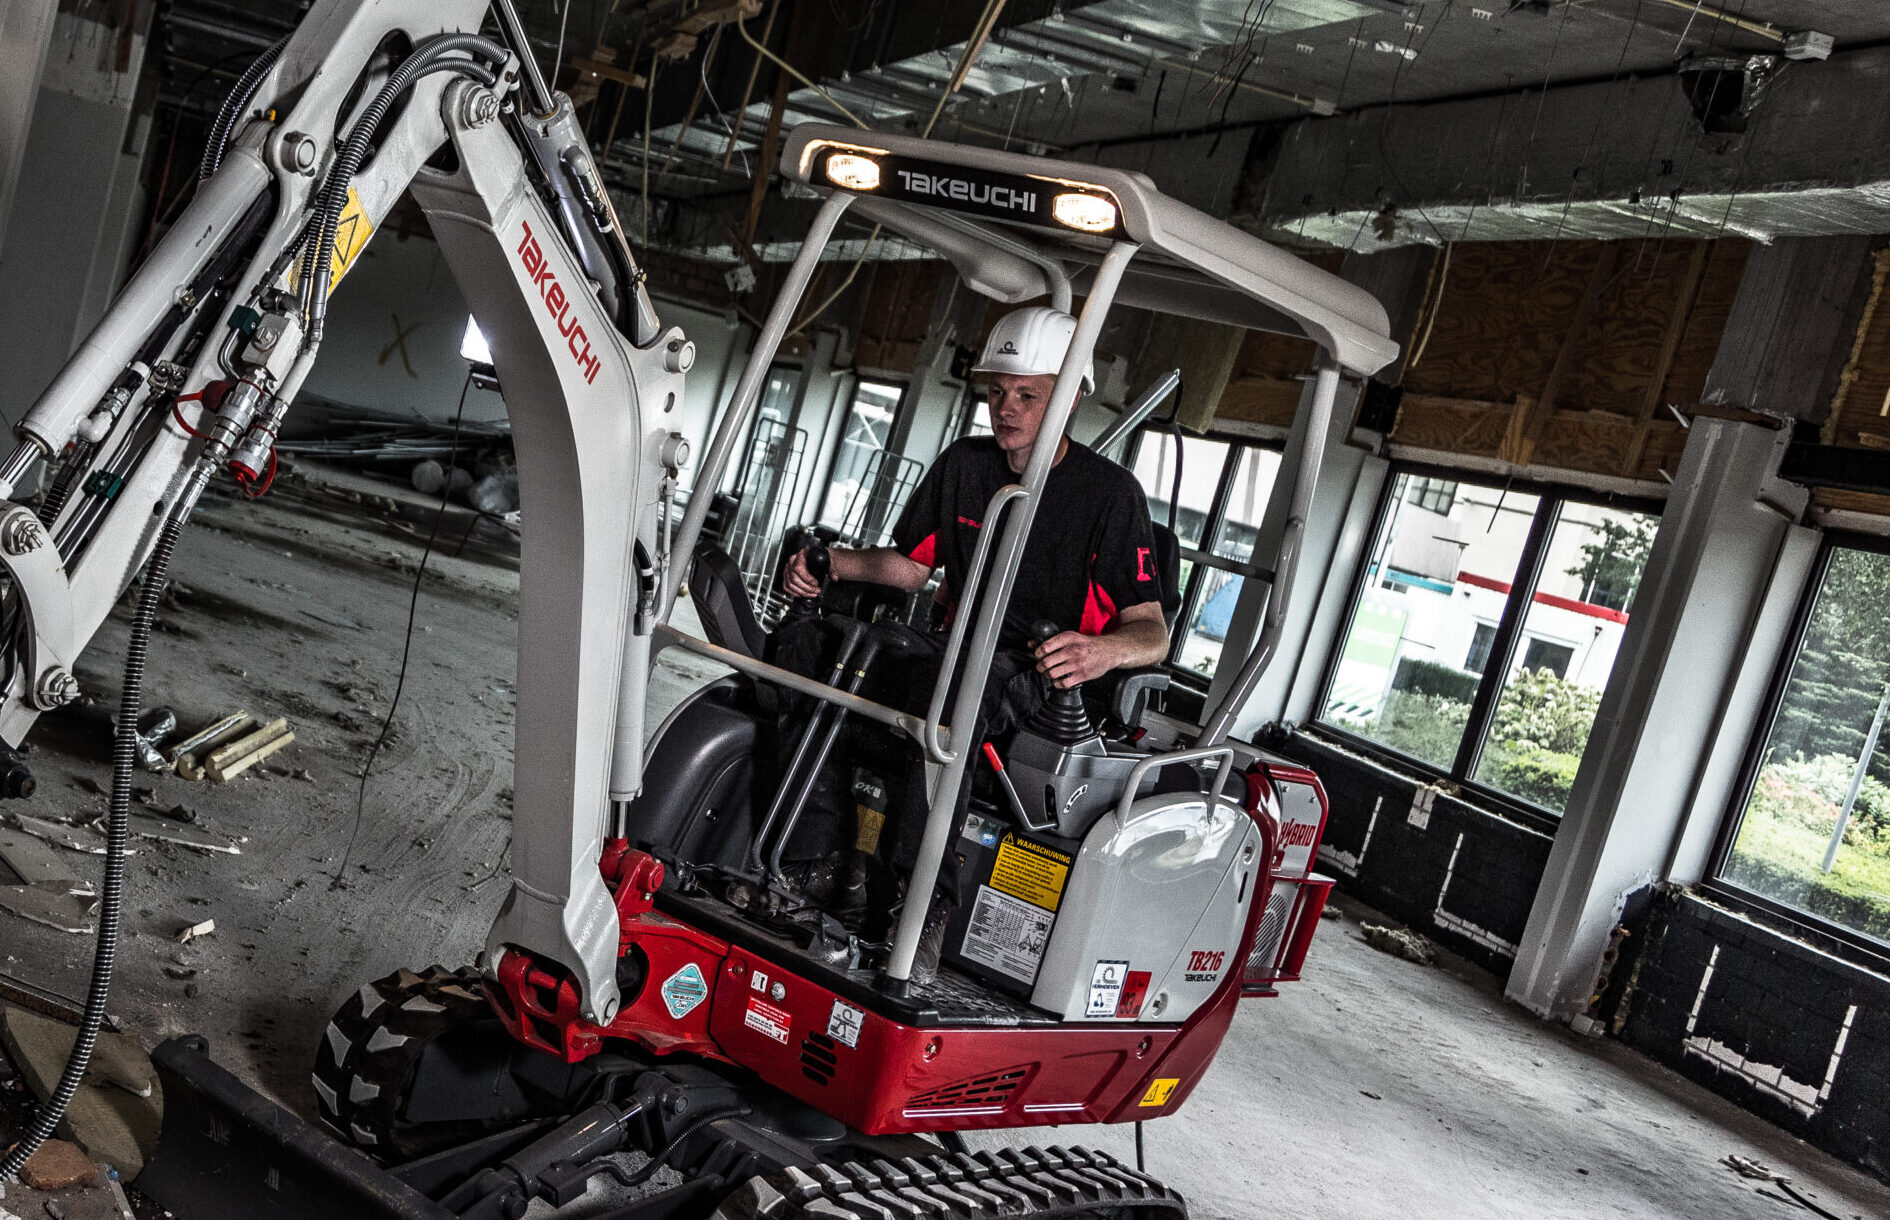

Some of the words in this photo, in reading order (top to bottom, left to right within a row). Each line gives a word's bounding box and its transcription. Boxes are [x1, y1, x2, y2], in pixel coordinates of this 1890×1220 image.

[898, 170, 1036, 213] TAKEUCHI
[517, 219, 602, 386] TAKEUCHI
[1015, 837, 1072, 865] WAARSCHUWING
[1187, 951, 1225, 972] TB216
[1184, 973, 1217, 982] TAKEUCHI
